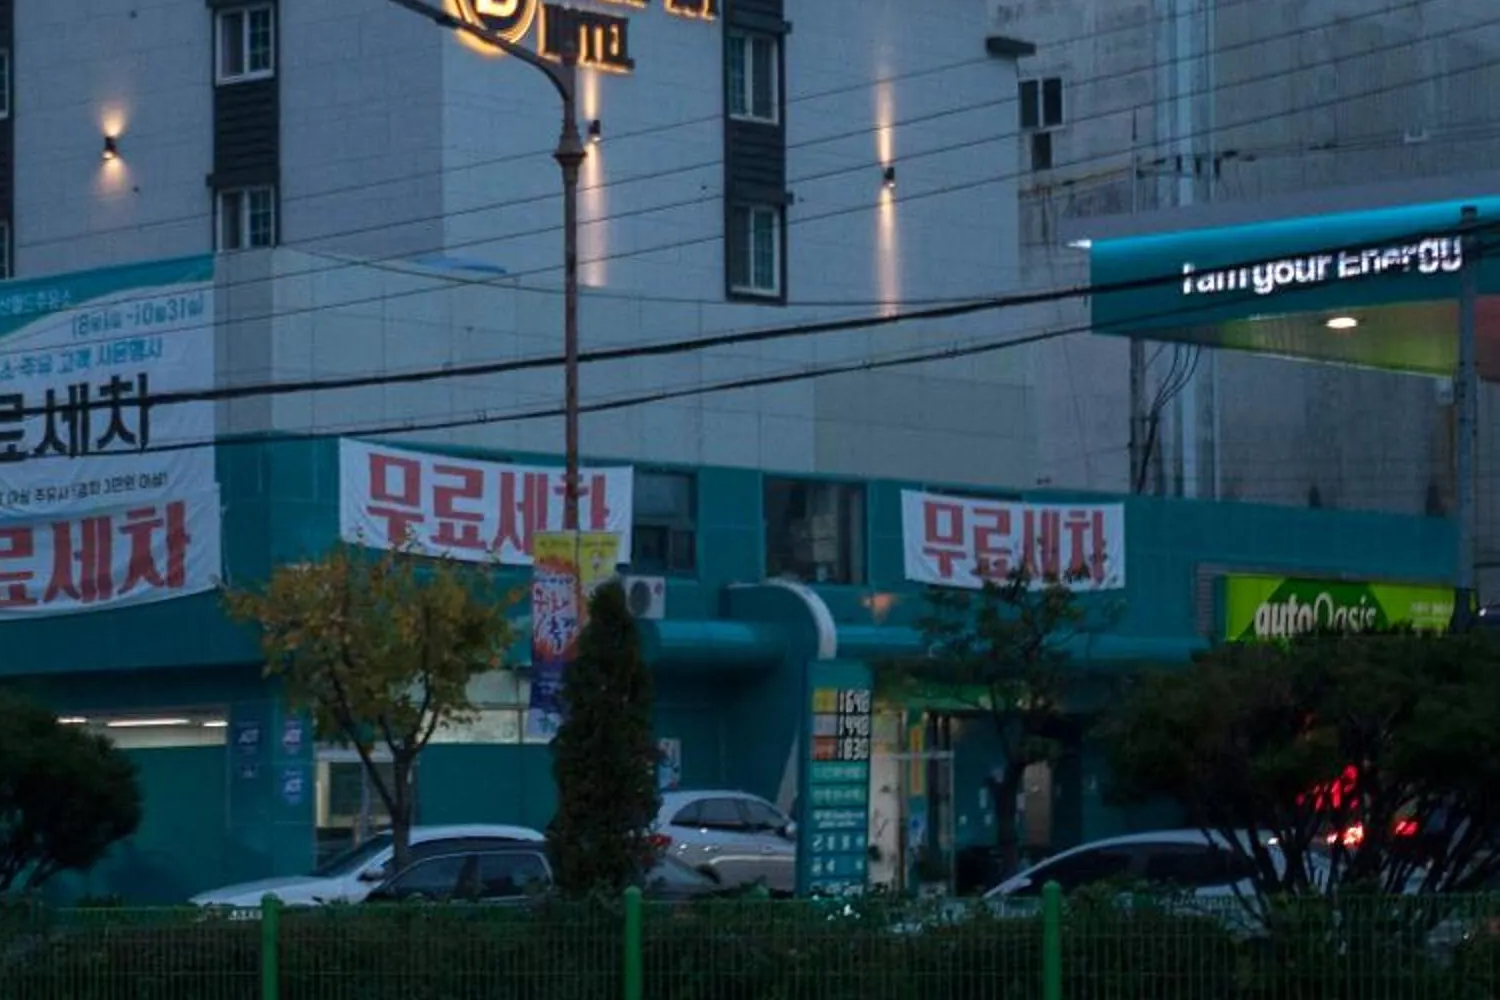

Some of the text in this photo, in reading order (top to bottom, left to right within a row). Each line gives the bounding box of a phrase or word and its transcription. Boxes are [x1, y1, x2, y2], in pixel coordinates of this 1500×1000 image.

[1252, 253, 1333, 296] your
[1337, 235, 1464, 280] Energy
[922, 501, 1107, 584] 무료세차
